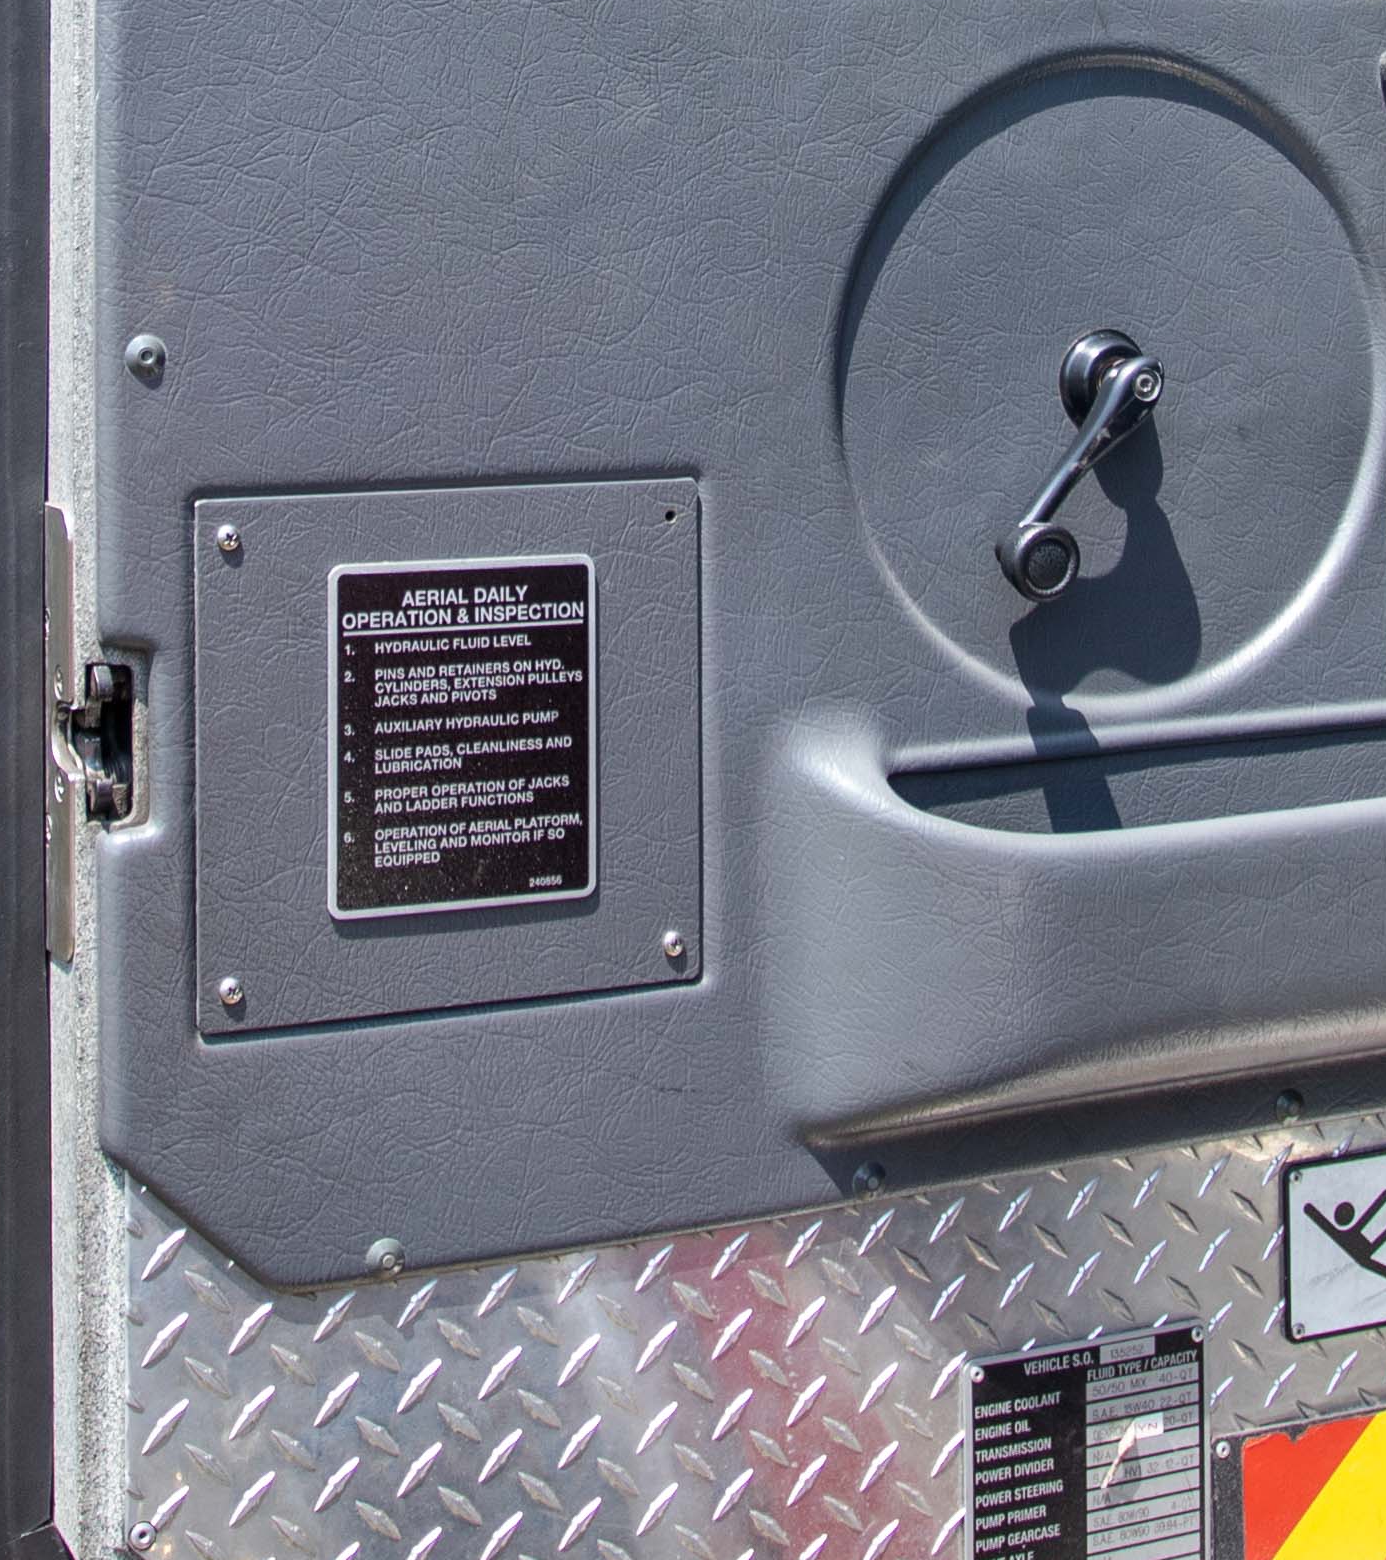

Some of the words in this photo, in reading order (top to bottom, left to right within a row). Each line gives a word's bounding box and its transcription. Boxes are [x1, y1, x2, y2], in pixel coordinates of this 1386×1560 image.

[401, 587, 469, 607] AERIAL
[473, 584, 528, 603] DAILY
[341, 607, 451, 629] OPERATION
[456, 607, 469, 623] &
[474, 600, 584, 623] INSPECTION
[344, 643, 355, 655] 1.
[374, 637, 449, 654] HYDRAULIC
[452, 636, 490, 650] FLUID
[492, 634, 531, 647] LEVEL
[343, 670, 355, 682] 2.
[374, 667, 405, 680] PINS
[407, 665, 435, 679] AND
[438, 661, 510, 677] RETAINERS
[512, 660, 532, 672] ON
[534, 658, 564, 671] HYD.
[374, 678, 451, 694] CYLINDERS,
[453, 673, 524, 689] EXTENSION
[527, 670, 583, 685] PULLEYS
[374, 693, 417, 707] JACKS
[420, 691, 448, 704] AND
[451, 688, 497, 703] PIVOTS
[343, 723, 355, 736] 3.
[374, 717, 443, 734] AUXILIARY
[445, 712, 519, 729] HYDRAULIC
[522, 710, 559, 724] PUMP
[343, 750, 355, 763] 4.
[374, 746, 412, 761] SLIDE
[415, 744, 453, 758] PADS,
[456, 737, 543, 755] CLEANLINESS
[545, 735, 572, 749] AND
[374, 756, 461, 774] LUBRICATION
[343, 790, 355, 803] 5.
[374, 785, 428, 801] PROPER
[431, 780, 505, 796] OPERATION
[508, 778, 525, 790] OF
[528, 774, 569, 789] JACKS
[374, 800, 402, 814] AND
[405, 796, 458, 812] LADDER
[460, 790, 534, 808] FUNCTIONS
[343, 831, 355, 843] 6.
[374, 823, 447, 841] OPERATION
[448, 821, 466, 835] OF
[468, 819, 512, 834] AERIAL
[514, 812, 582, 829] PLATFORM,
[374, 837, 437, 854] LEVELING
[439, 835, 467, 849] AND
[470, 830, 530, 846] MONITOR
[533, 828, 544, 841] IF
[547, 827, 565, 839] SO
[374, 850, 440, 868] EQUIPPED
[1023, 1354, 1069, 1376] VEHICLE
[1072, 1351, 1093, 1367] S.O.
[1086, 1365, 1115, 1381] FLUID
[1117, 1359, 1141, 1376] TYPE
[1150, 1349, 1197, 1369] CAPACITY
[974, 1400, 1012, 1419] ENGINE
[1013, 1391, 1060, 1412] COOLANT
[974, 1421, 1012, 1442] ENGINE
[1014, 1419, 1031, 1434] OIL
[974, 1436, 1051, 1463] TRANSMISSION
[974, 1465, 1011, 1485] POWER
[1013, 1457, 1054, 1477] DIVIDER
[975, 1489, 1012, 1508] POWER
[1014, 1479, 1063, 1500] STEERING
[975, 1512, 1005, 1531] PUMP
[1007, 1504, 1046, 1524] PRIMER
[975, 1535, 1005, 1553] PUMP
[1007, 1523, 1060, 1546] GEARCASE
